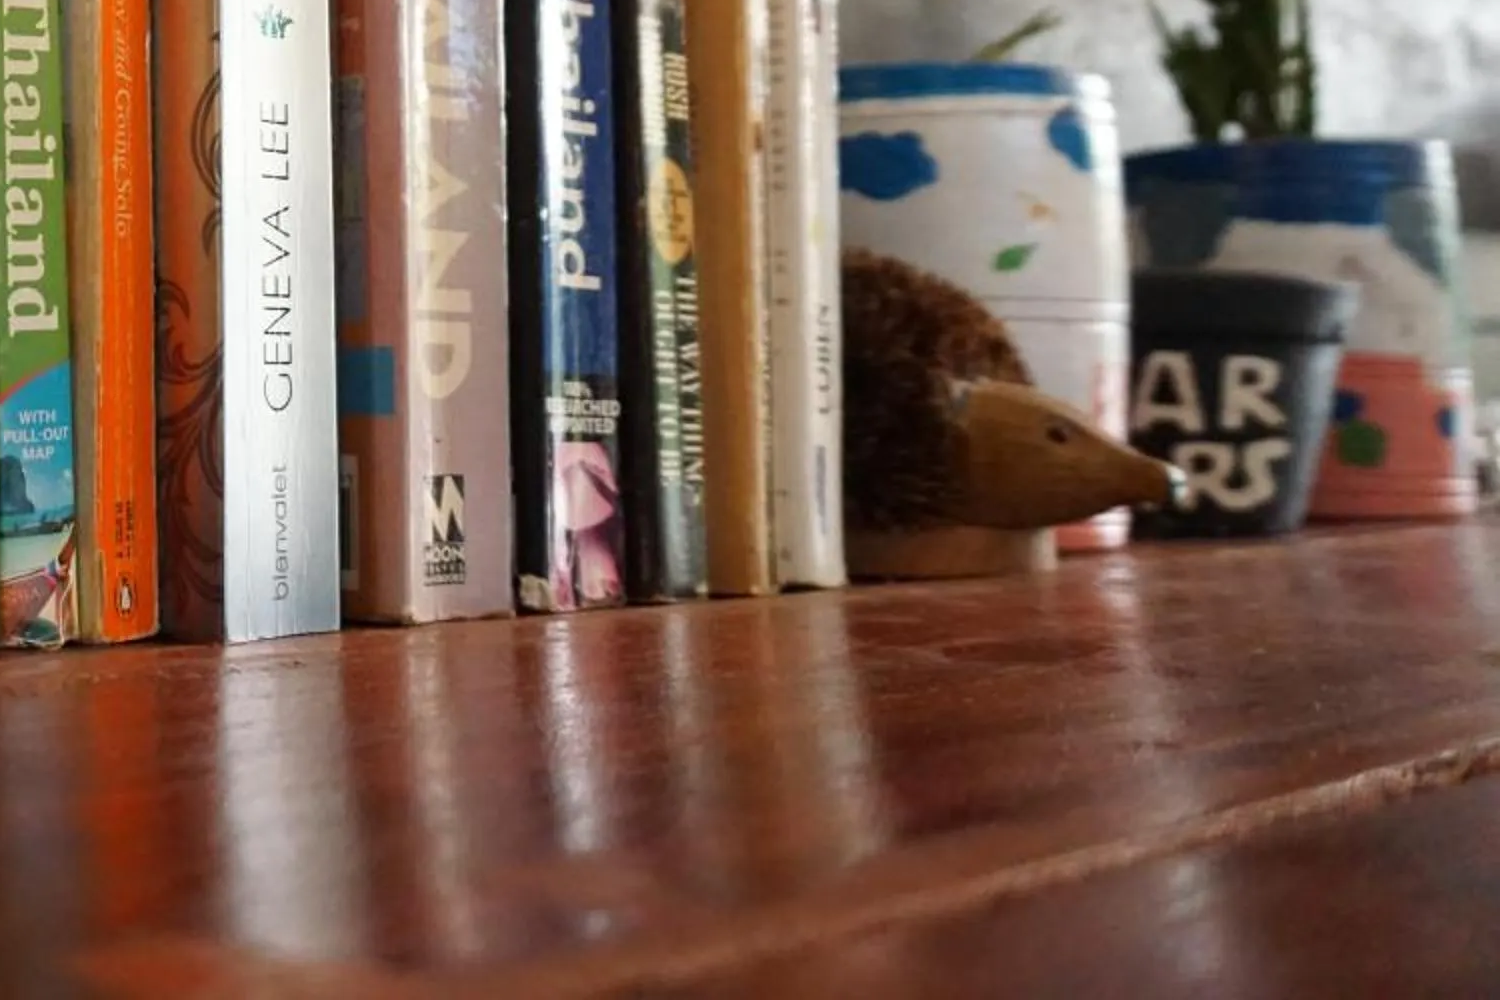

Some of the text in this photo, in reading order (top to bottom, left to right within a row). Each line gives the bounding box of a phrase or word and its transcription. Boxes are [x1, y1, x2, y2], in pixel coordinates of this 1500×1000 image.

[260, 102, 293, 413] GENEVA LEE
[19, 408, 56, 426] WITH
[3, 425, 69, 444] PULL-OUT
[22, 445, 55, 461] MAP
[270, 465, 290, 601] blanvalet
